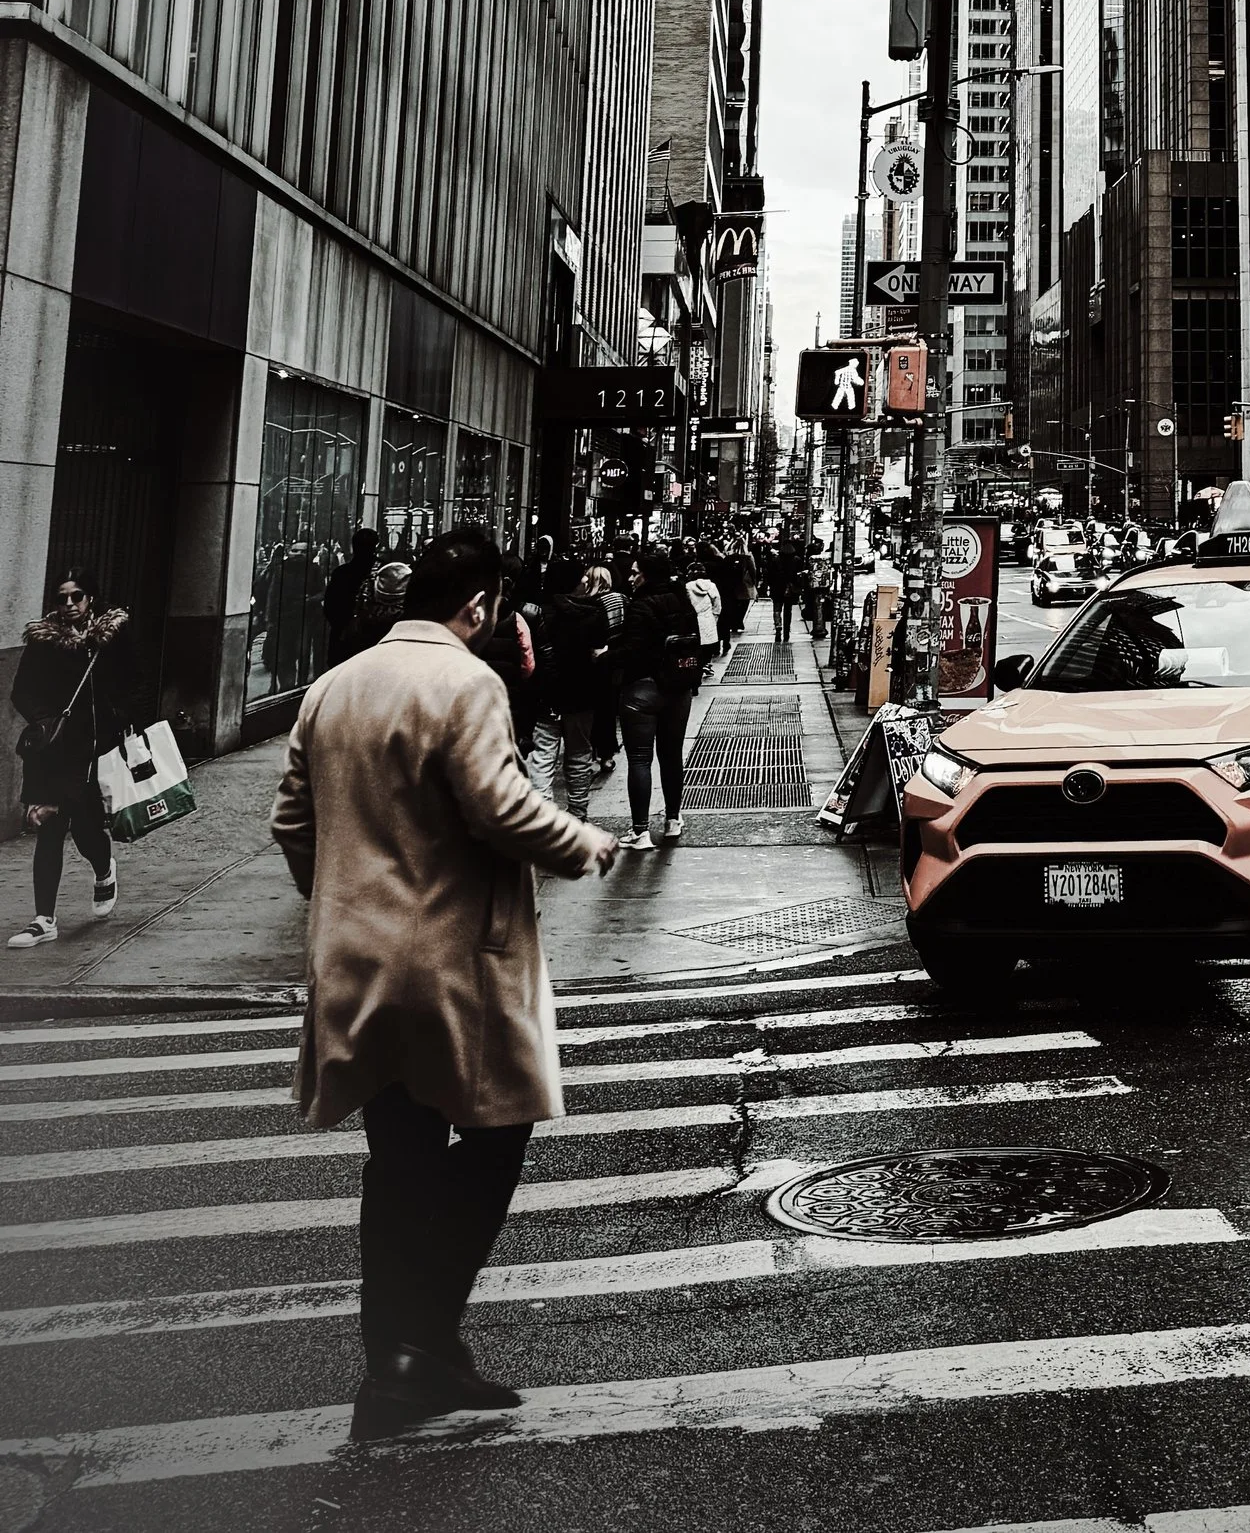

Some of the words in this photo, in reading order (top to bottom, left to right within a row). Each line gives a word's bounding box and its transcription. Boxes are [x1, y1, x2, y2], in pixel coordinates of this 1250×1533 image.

[888, 146, 920, 155] URUGUAY
[598, 389, 665, 408] 1212
[943, 547, 970, 556] TALY
[1064, 864, 1081, 872] NEW
[1083, 864, 1104, 872] YORK
[1052, 874, 1116, 897] Y201284C
